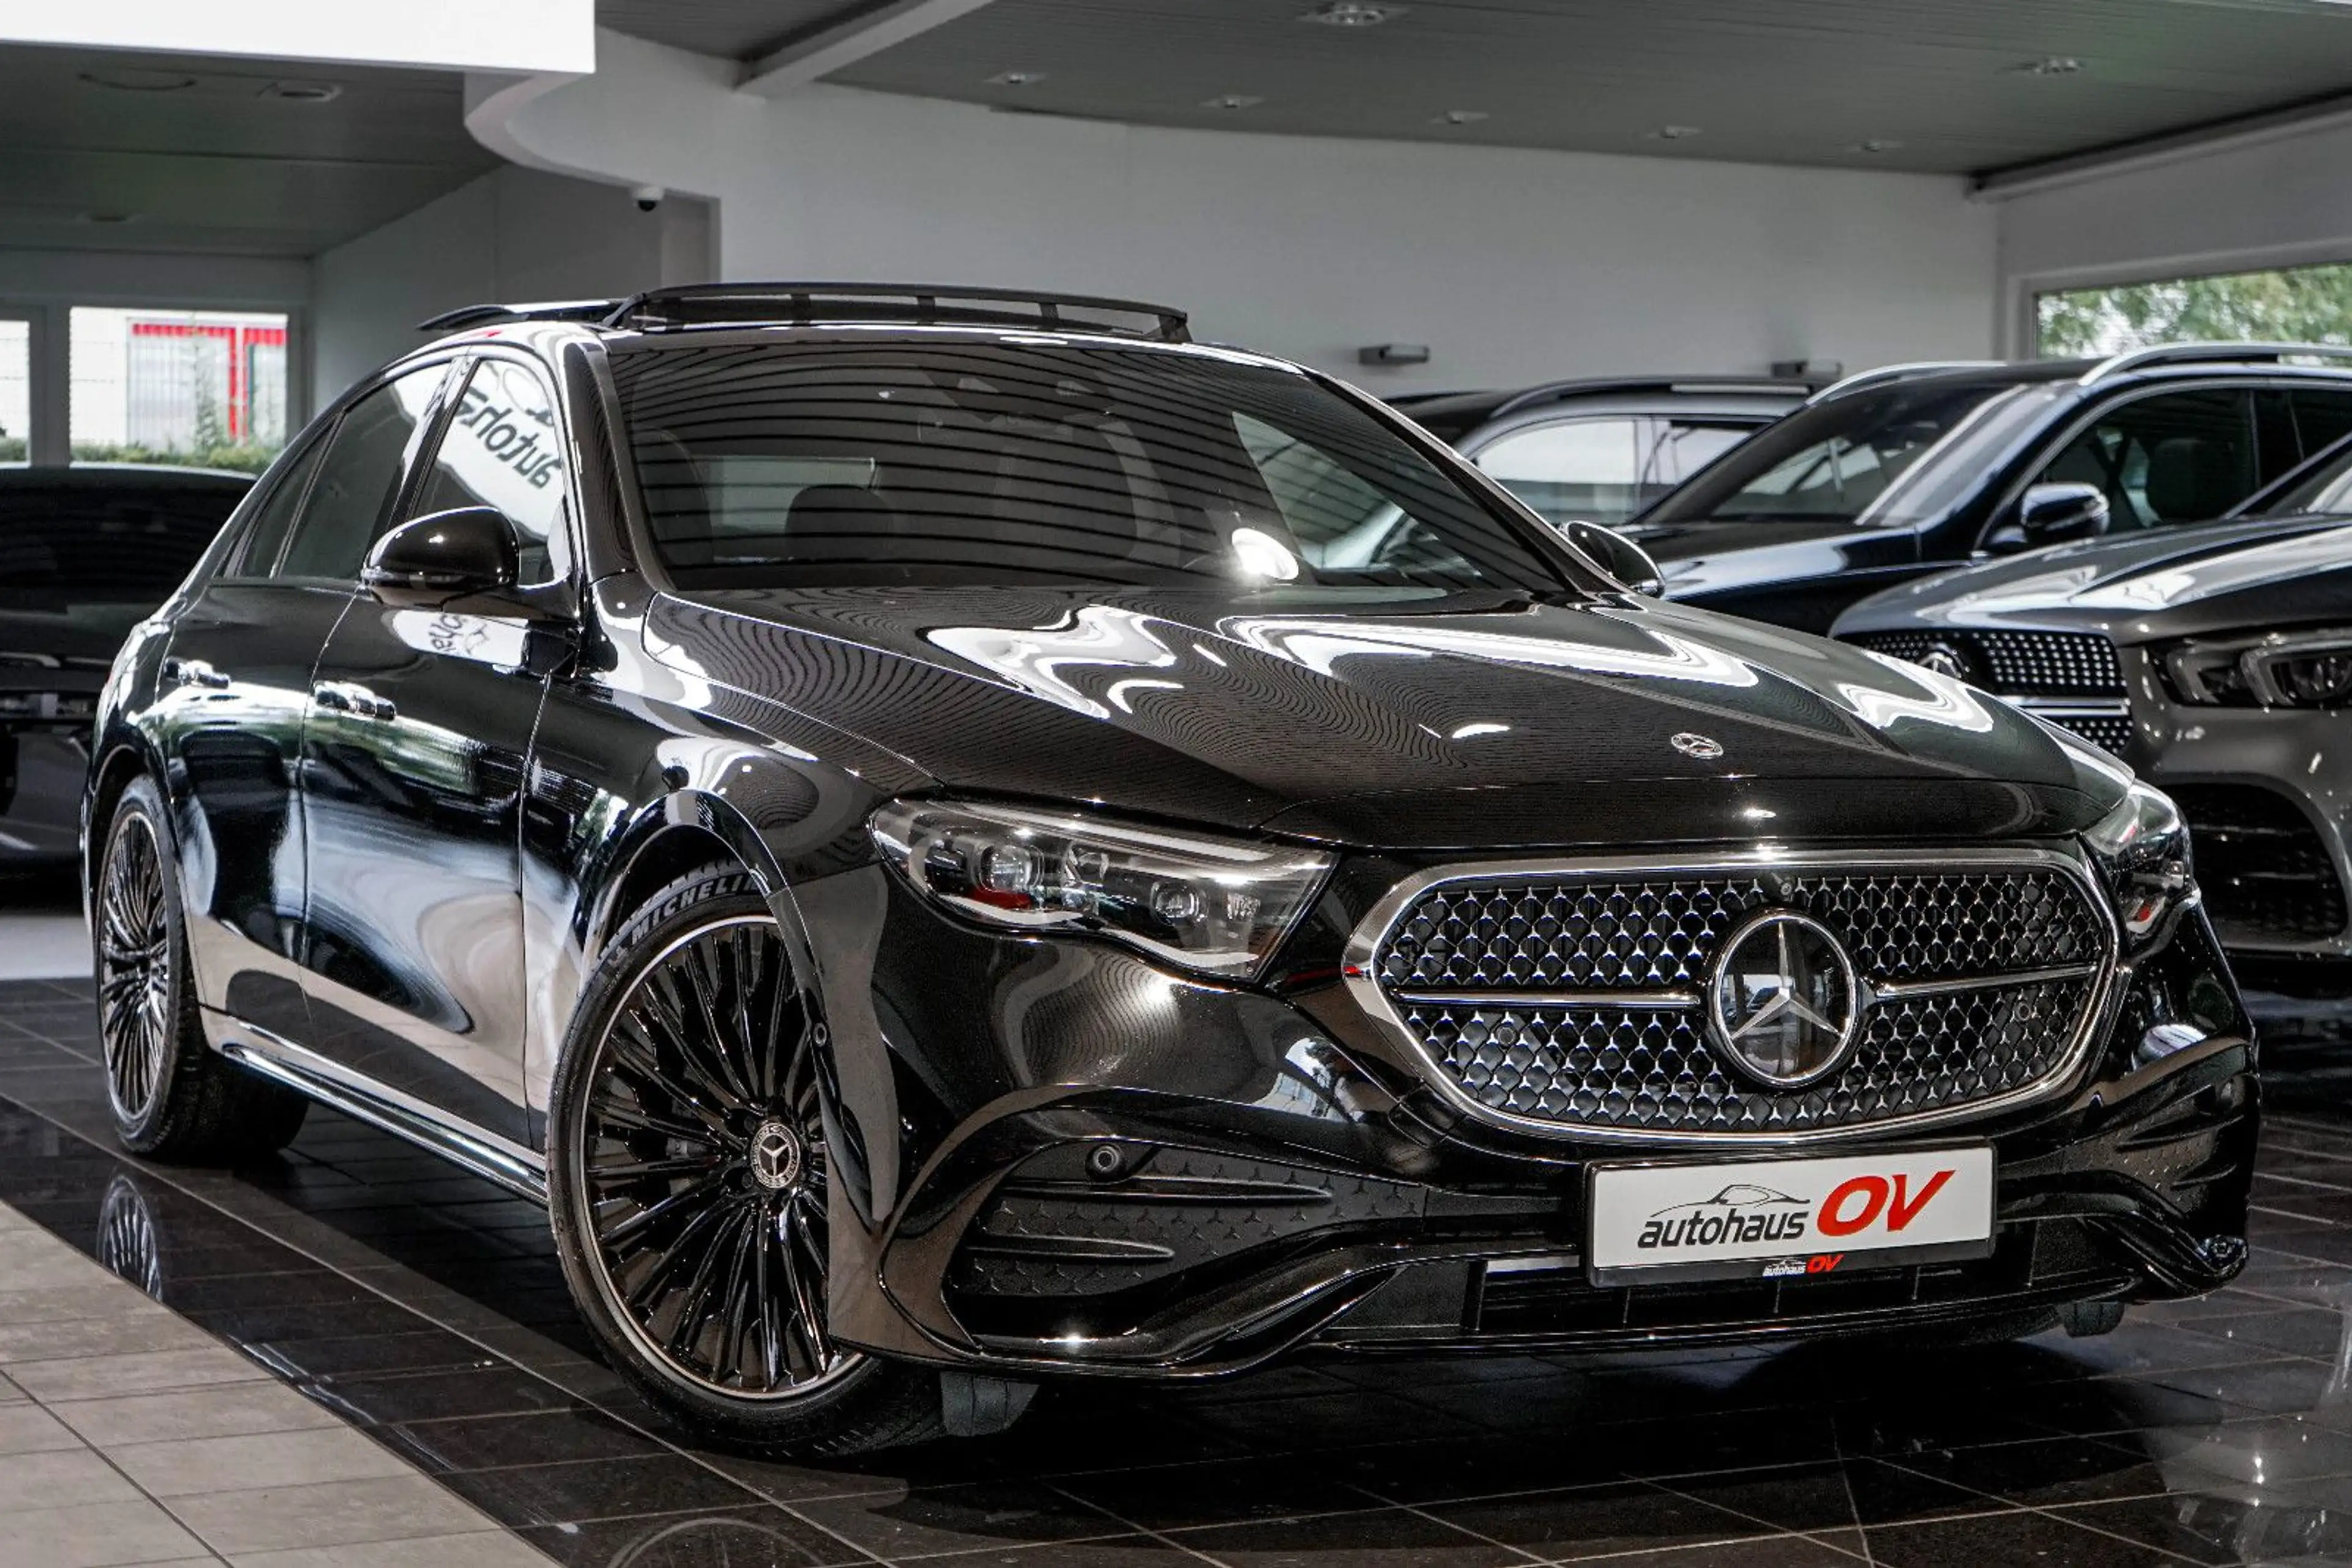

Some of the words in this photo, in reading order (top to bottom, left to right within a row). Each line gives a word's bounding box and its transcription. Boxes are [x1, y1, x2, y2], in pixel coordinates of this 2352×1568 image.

[1637, 1208, 1809, 1248] autohaus
[1817, 1170, 1955, 1237] OV
[1762, 1263, 1806, 1276] autohaus
[1807, 1254, 1845, 1273] OV
